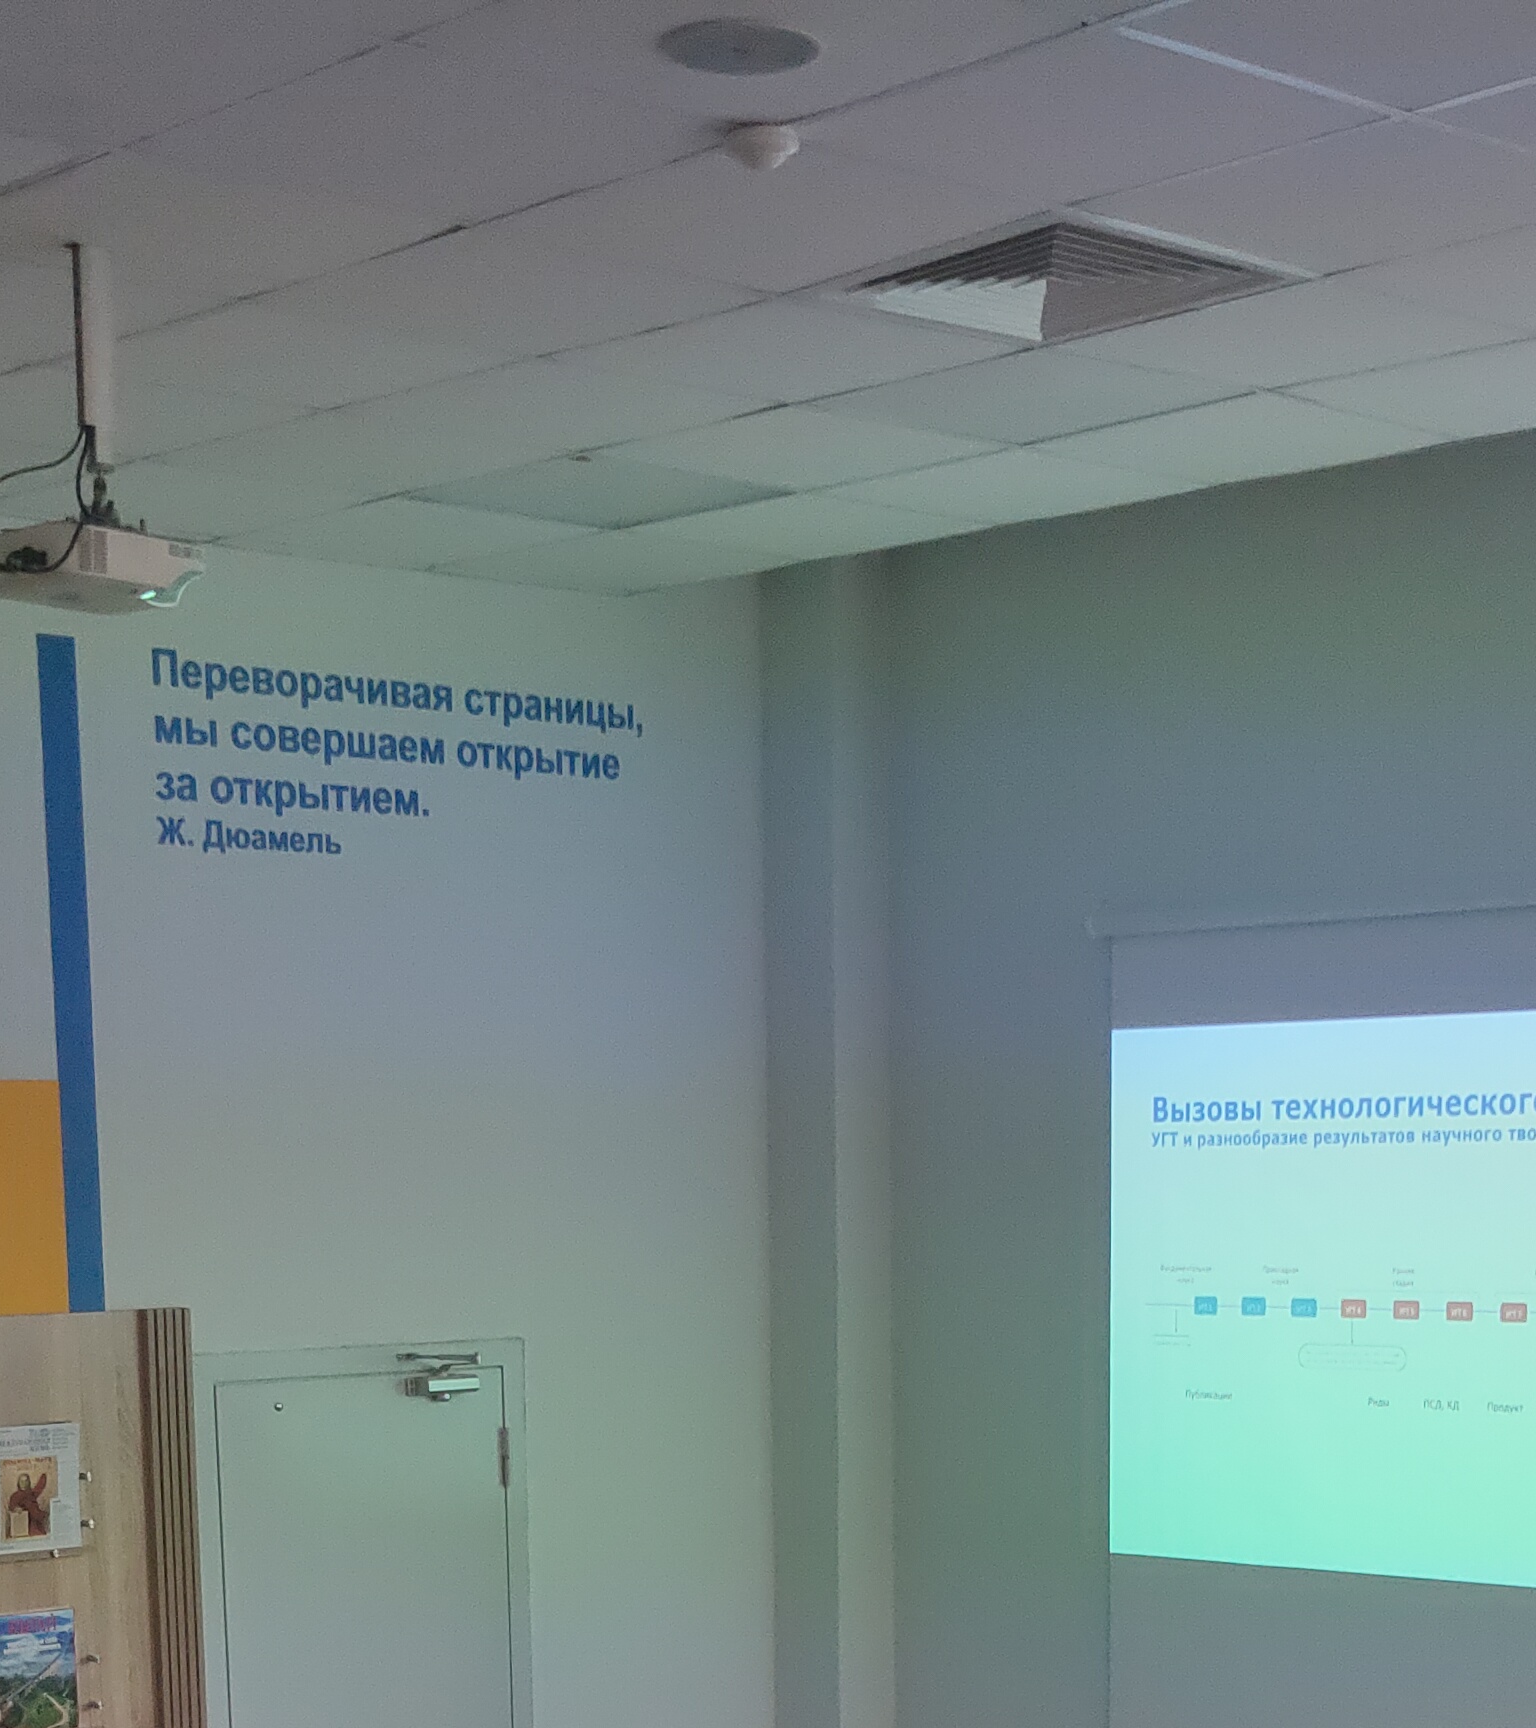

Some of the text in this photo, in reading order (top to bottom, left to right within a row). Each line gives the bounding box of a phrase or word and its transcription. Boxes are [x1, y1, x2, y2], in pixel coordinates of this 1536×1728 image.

[151, 648, 644, 737] Переворачивая страницы,
[154, 714, 621, 781] мы совершаем открытие
[156, 771, 431, 818] за открытием.
[156, 815, 342, 855] Ж. Дюамель
[1152, 1095, 1262, 1123] Вызовы
[1150, 1131, 1179, 1148] УГТ
[1183, 1134, 1192, 1147] и
[1197, 1129, 1308, 1150] разнообразие
[1313, 1129, 1415, 1149] результатов
[1421, 1126, 1502, 1147] научного
